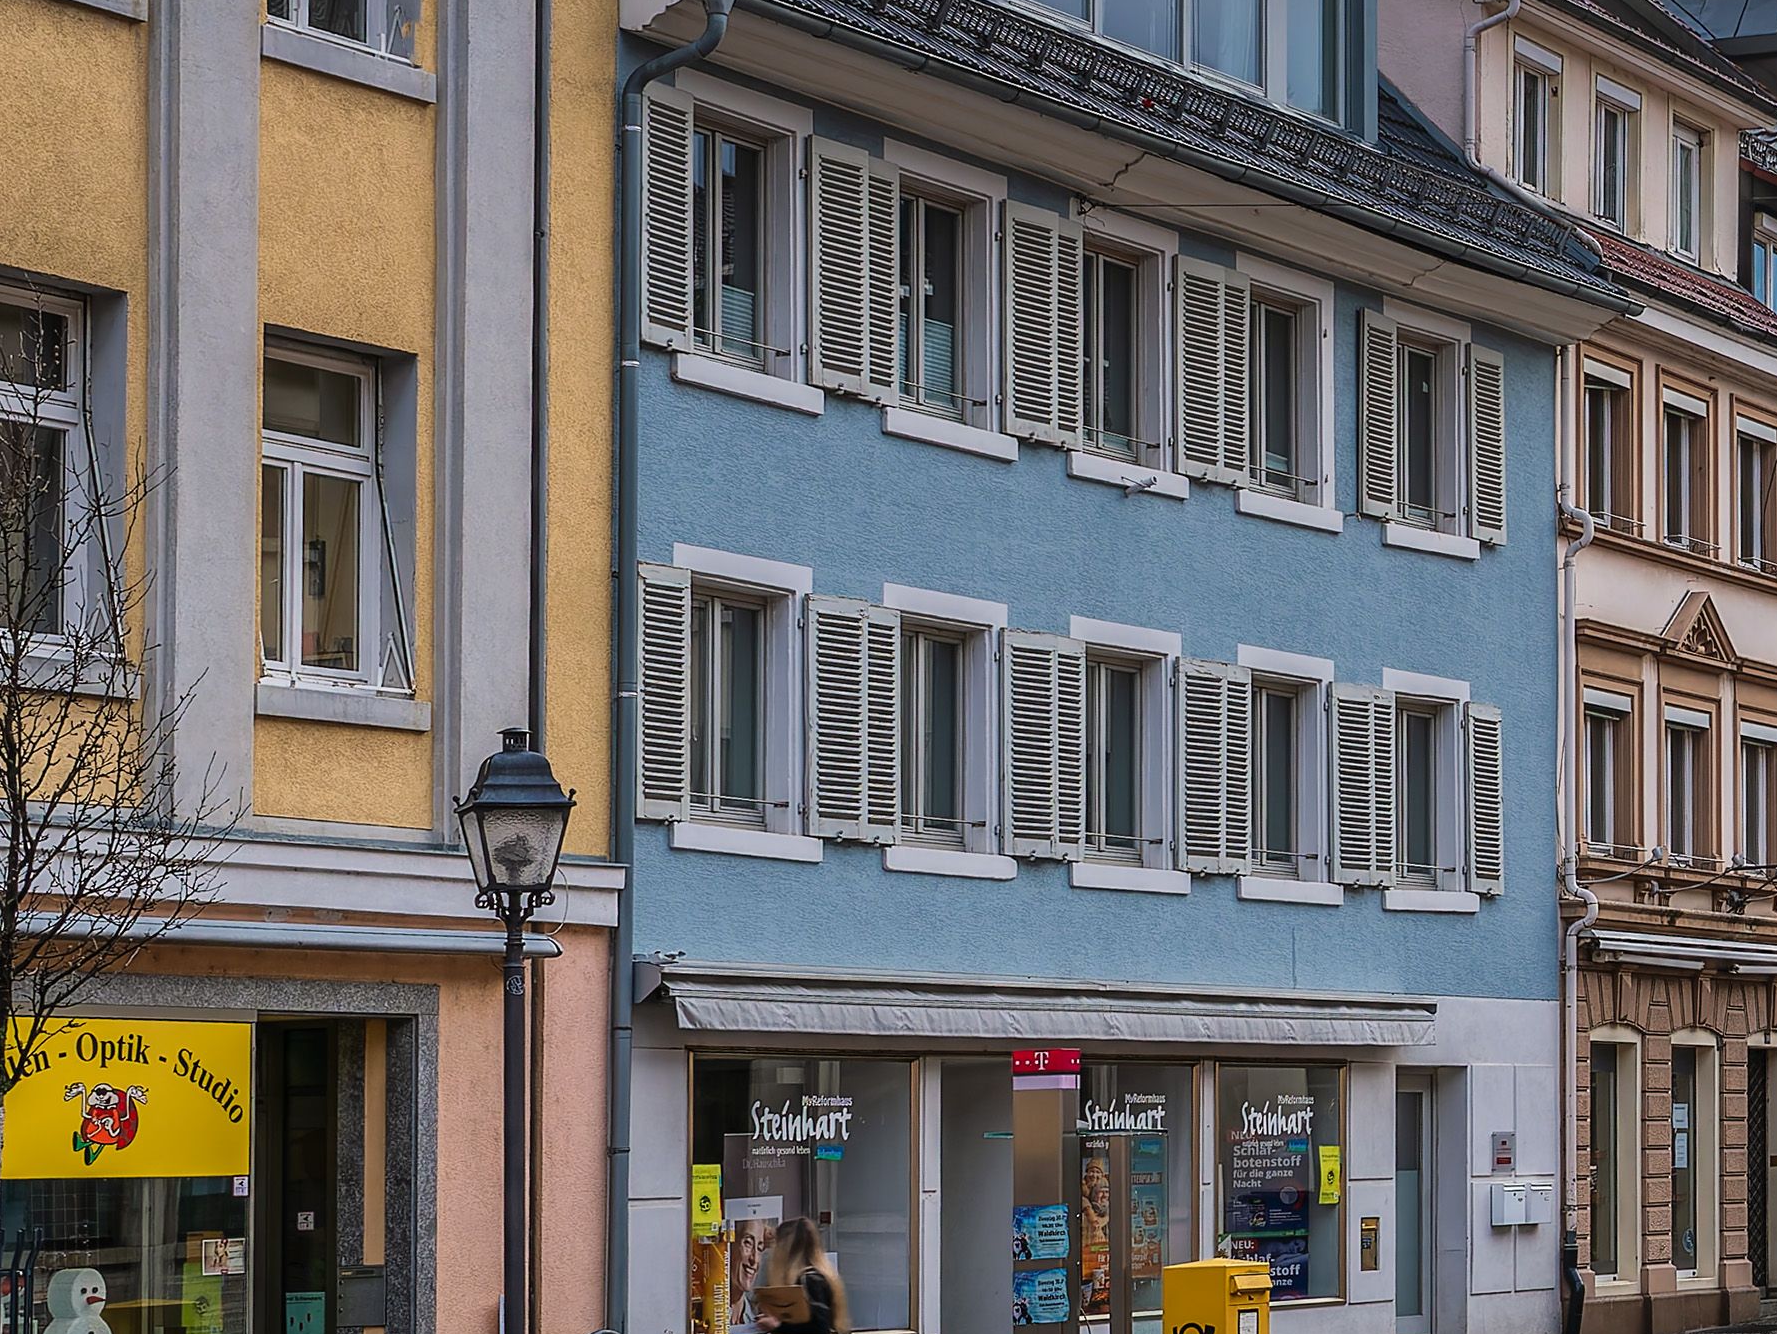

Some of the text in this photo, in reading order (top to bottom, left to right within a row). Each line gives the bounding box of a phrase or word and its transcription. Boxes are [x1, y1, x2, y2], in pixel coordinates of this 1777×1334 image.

[1034, 1051, 1049, 1071] T
[75, 1032, 150, 1069] Optik
[173, 1047, 243, 1124] Studio
[801, 1095, 853, 1107] MyReformhaus
[751, 1099, 852, 1141] Steinhart
[1085, 1098, 1166, 1131] Steinhart
[1242, 1100, 1314, 1136] Steinhart
[1233, 1145, 1276, 1156] Schlaf-
[1233, 1155, 1302, 1168] botenstoff
[1233, 1169, 1293, 1179] für die ganze
[1233, 1180, 1262, 1188] Nacht
[1038, 1229, 1066, 1237] Waldkirch
[1038, 1294, 1066, 1303] Waldkirch
